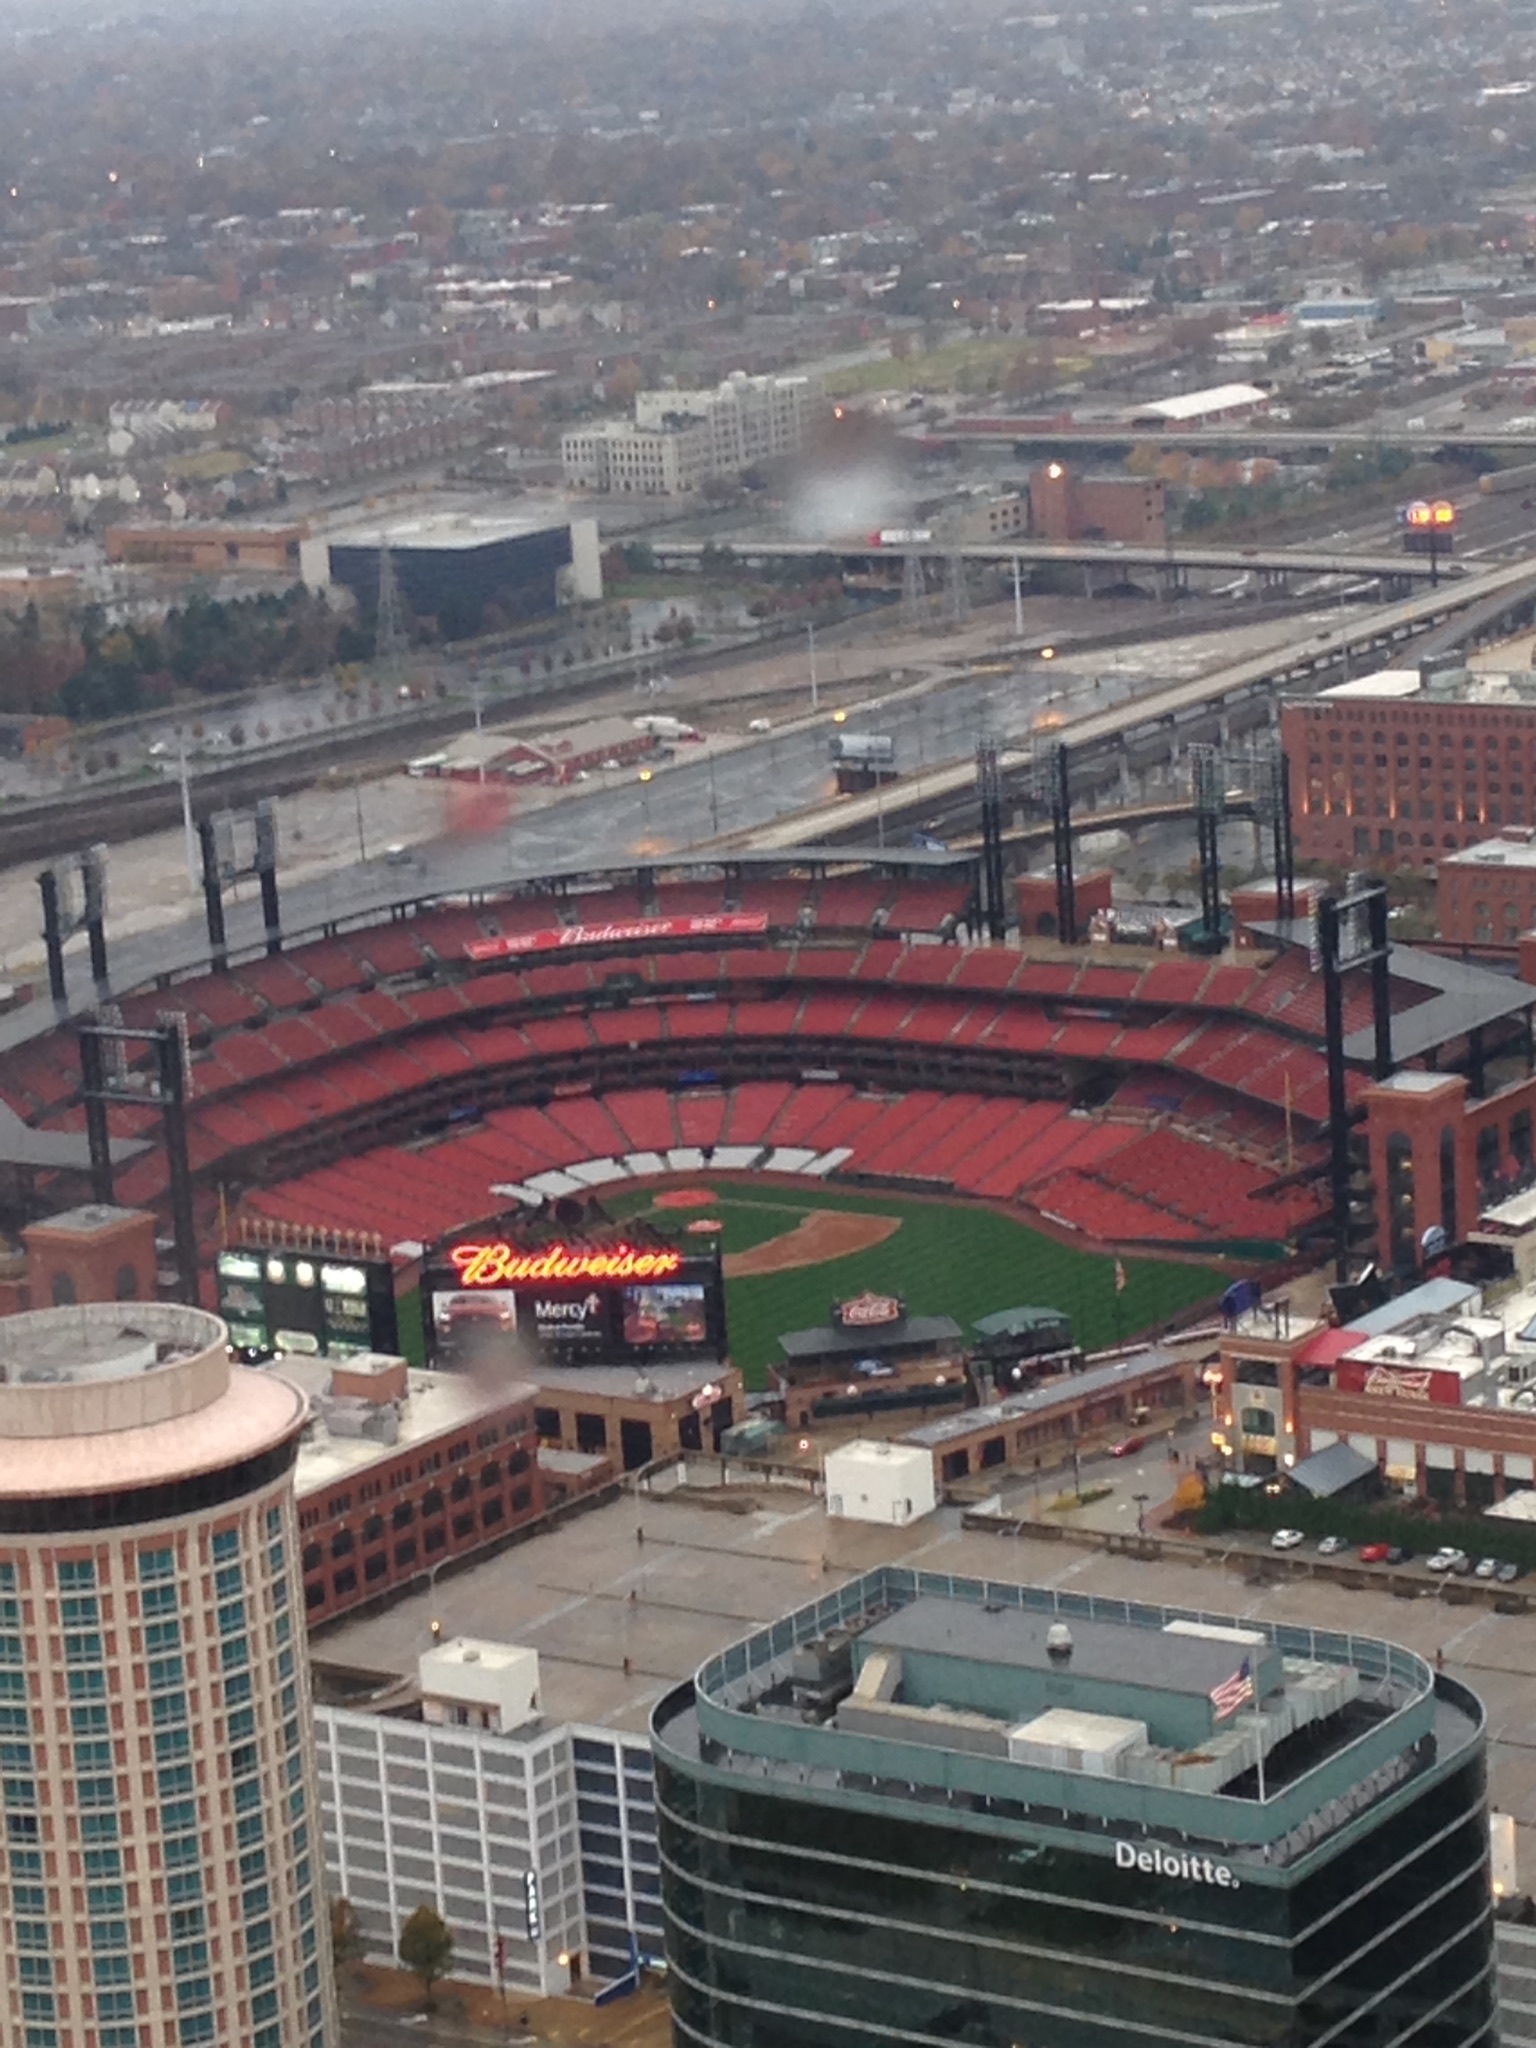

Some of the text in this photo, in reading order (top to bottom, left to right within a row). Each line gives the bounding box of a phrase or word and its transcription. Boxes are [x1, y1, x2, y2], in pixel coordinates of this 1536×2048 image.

[559, 921, 672, 944] Budweiser
[451, 1243, 679, 1286] Budweiser
[535, 1300, 588, 1321] Mercy
